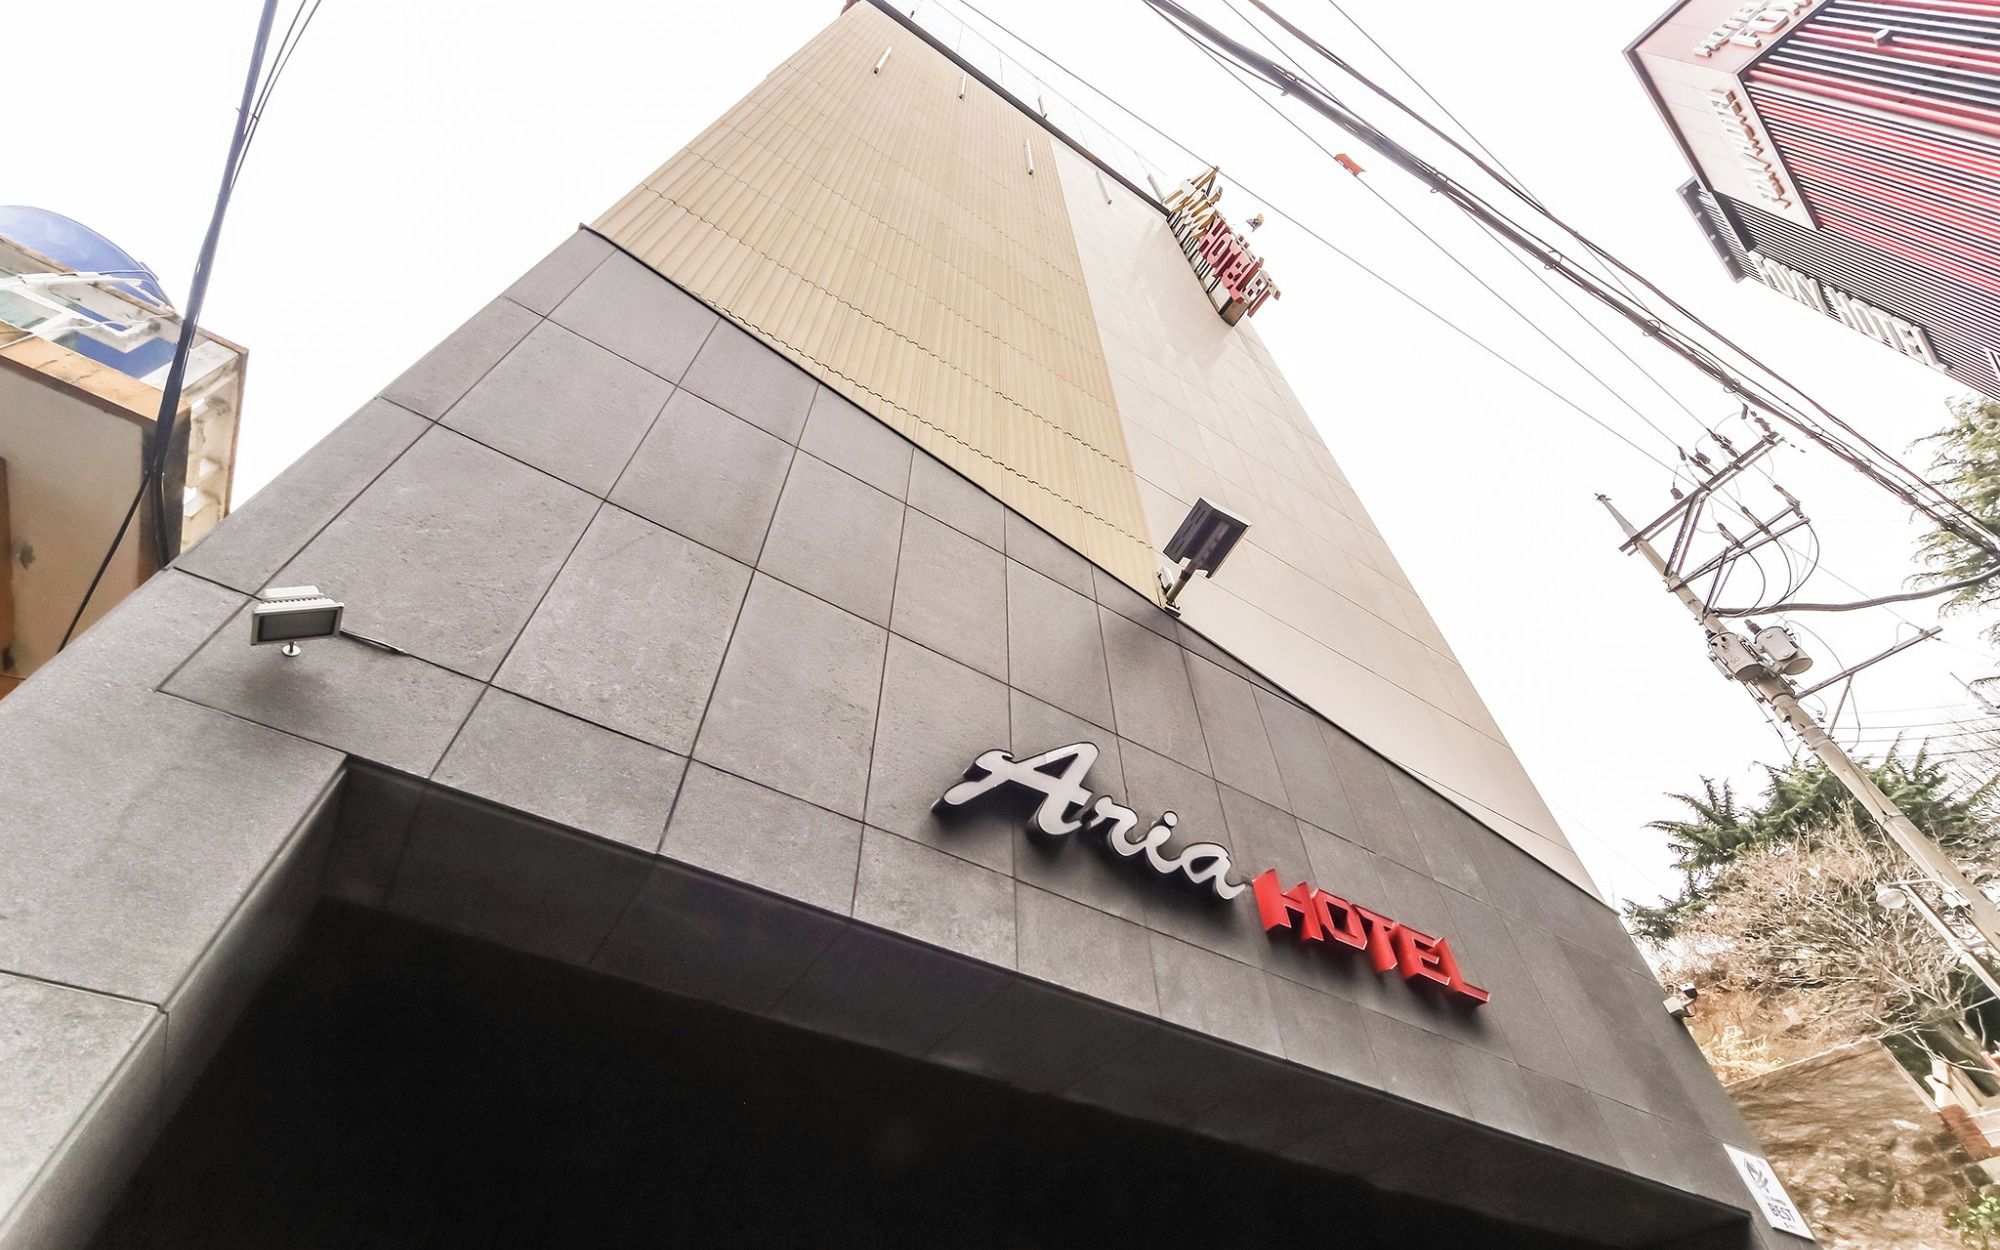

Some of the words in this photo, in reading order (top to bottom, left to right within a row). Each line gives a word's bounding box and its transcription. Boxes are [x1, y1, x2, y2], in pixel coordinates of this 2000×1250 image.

[1823, 285, 1949, 375] HOTEL
[932, 741, 1245, 900] Aria
[1251, 869, 1489, 1006] HOTEL
[1767, 1202, 1796, 1222] BEST
